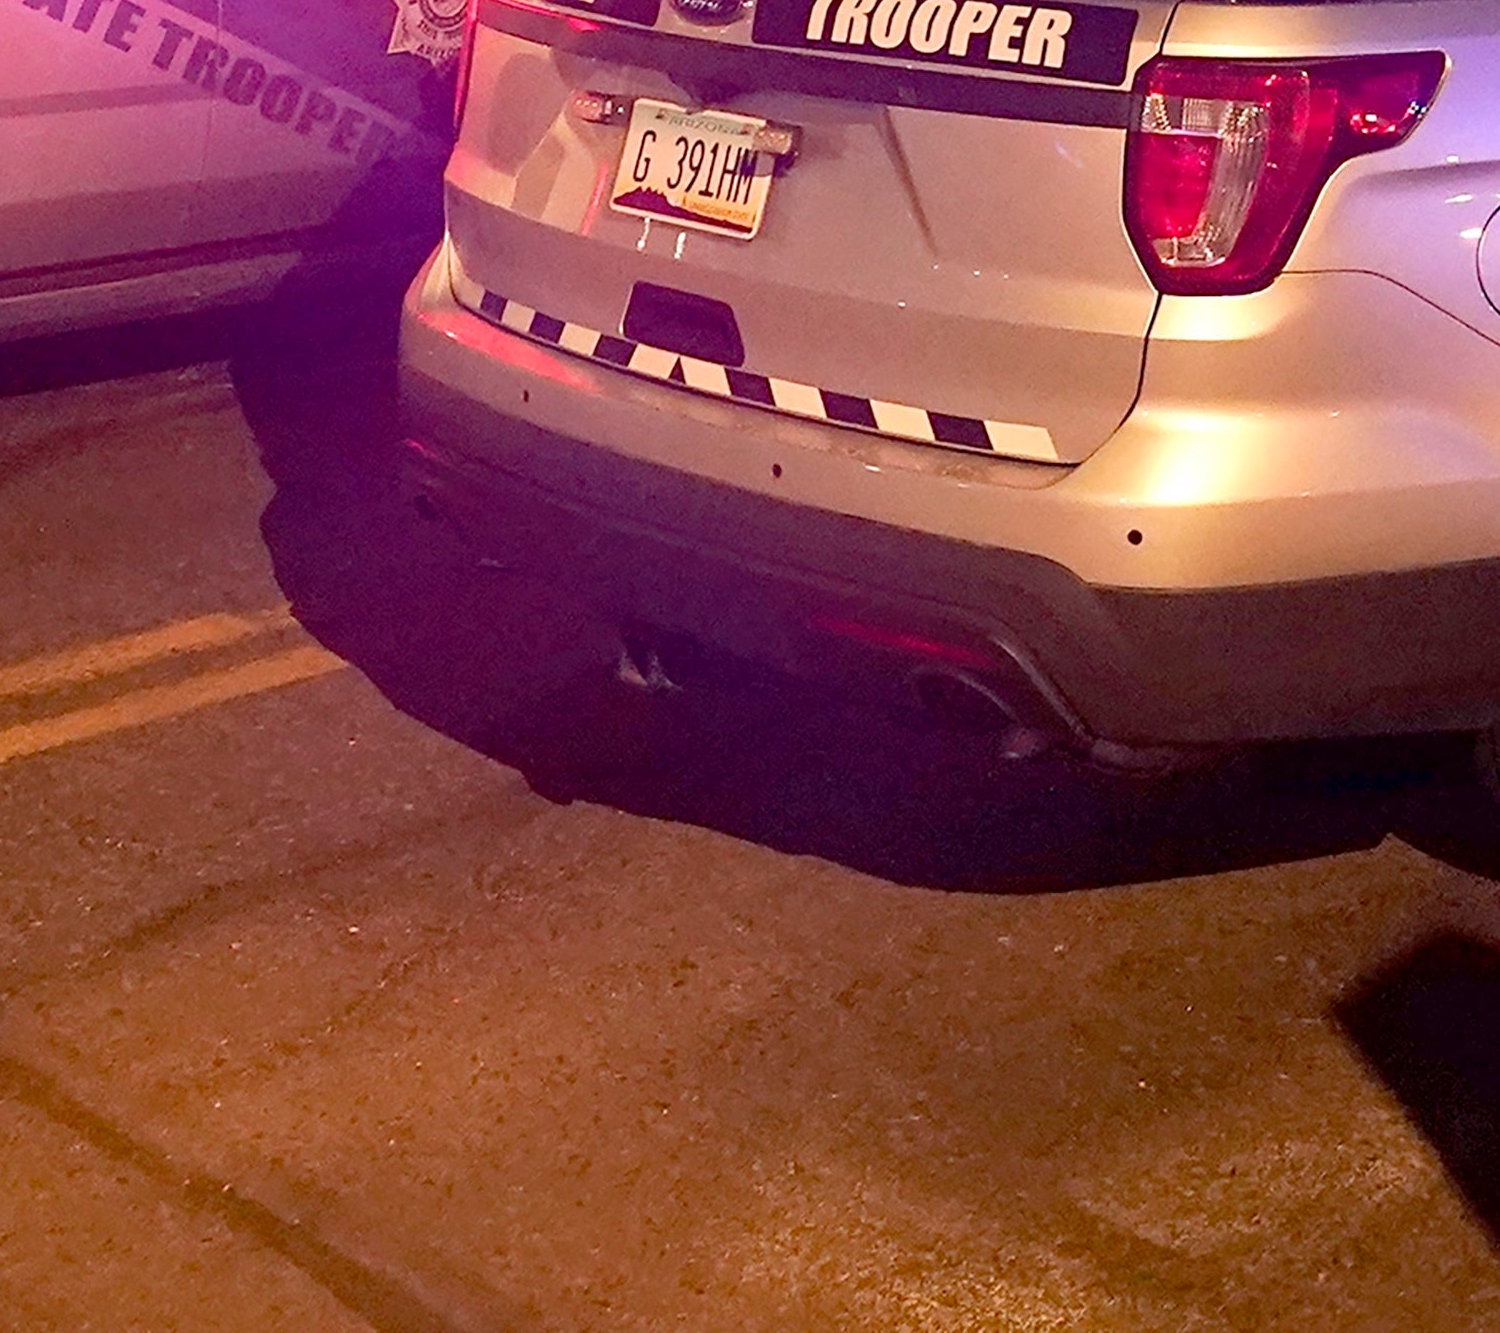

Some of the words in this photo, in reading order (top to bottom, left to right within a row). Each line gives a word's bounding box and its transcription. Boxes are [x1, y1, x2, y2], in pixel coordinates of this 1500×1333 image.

[151, 17, 397, 165] TROOPER
[633, 130, 657, 183] G
[667, 136, 760, 205] 391HM
